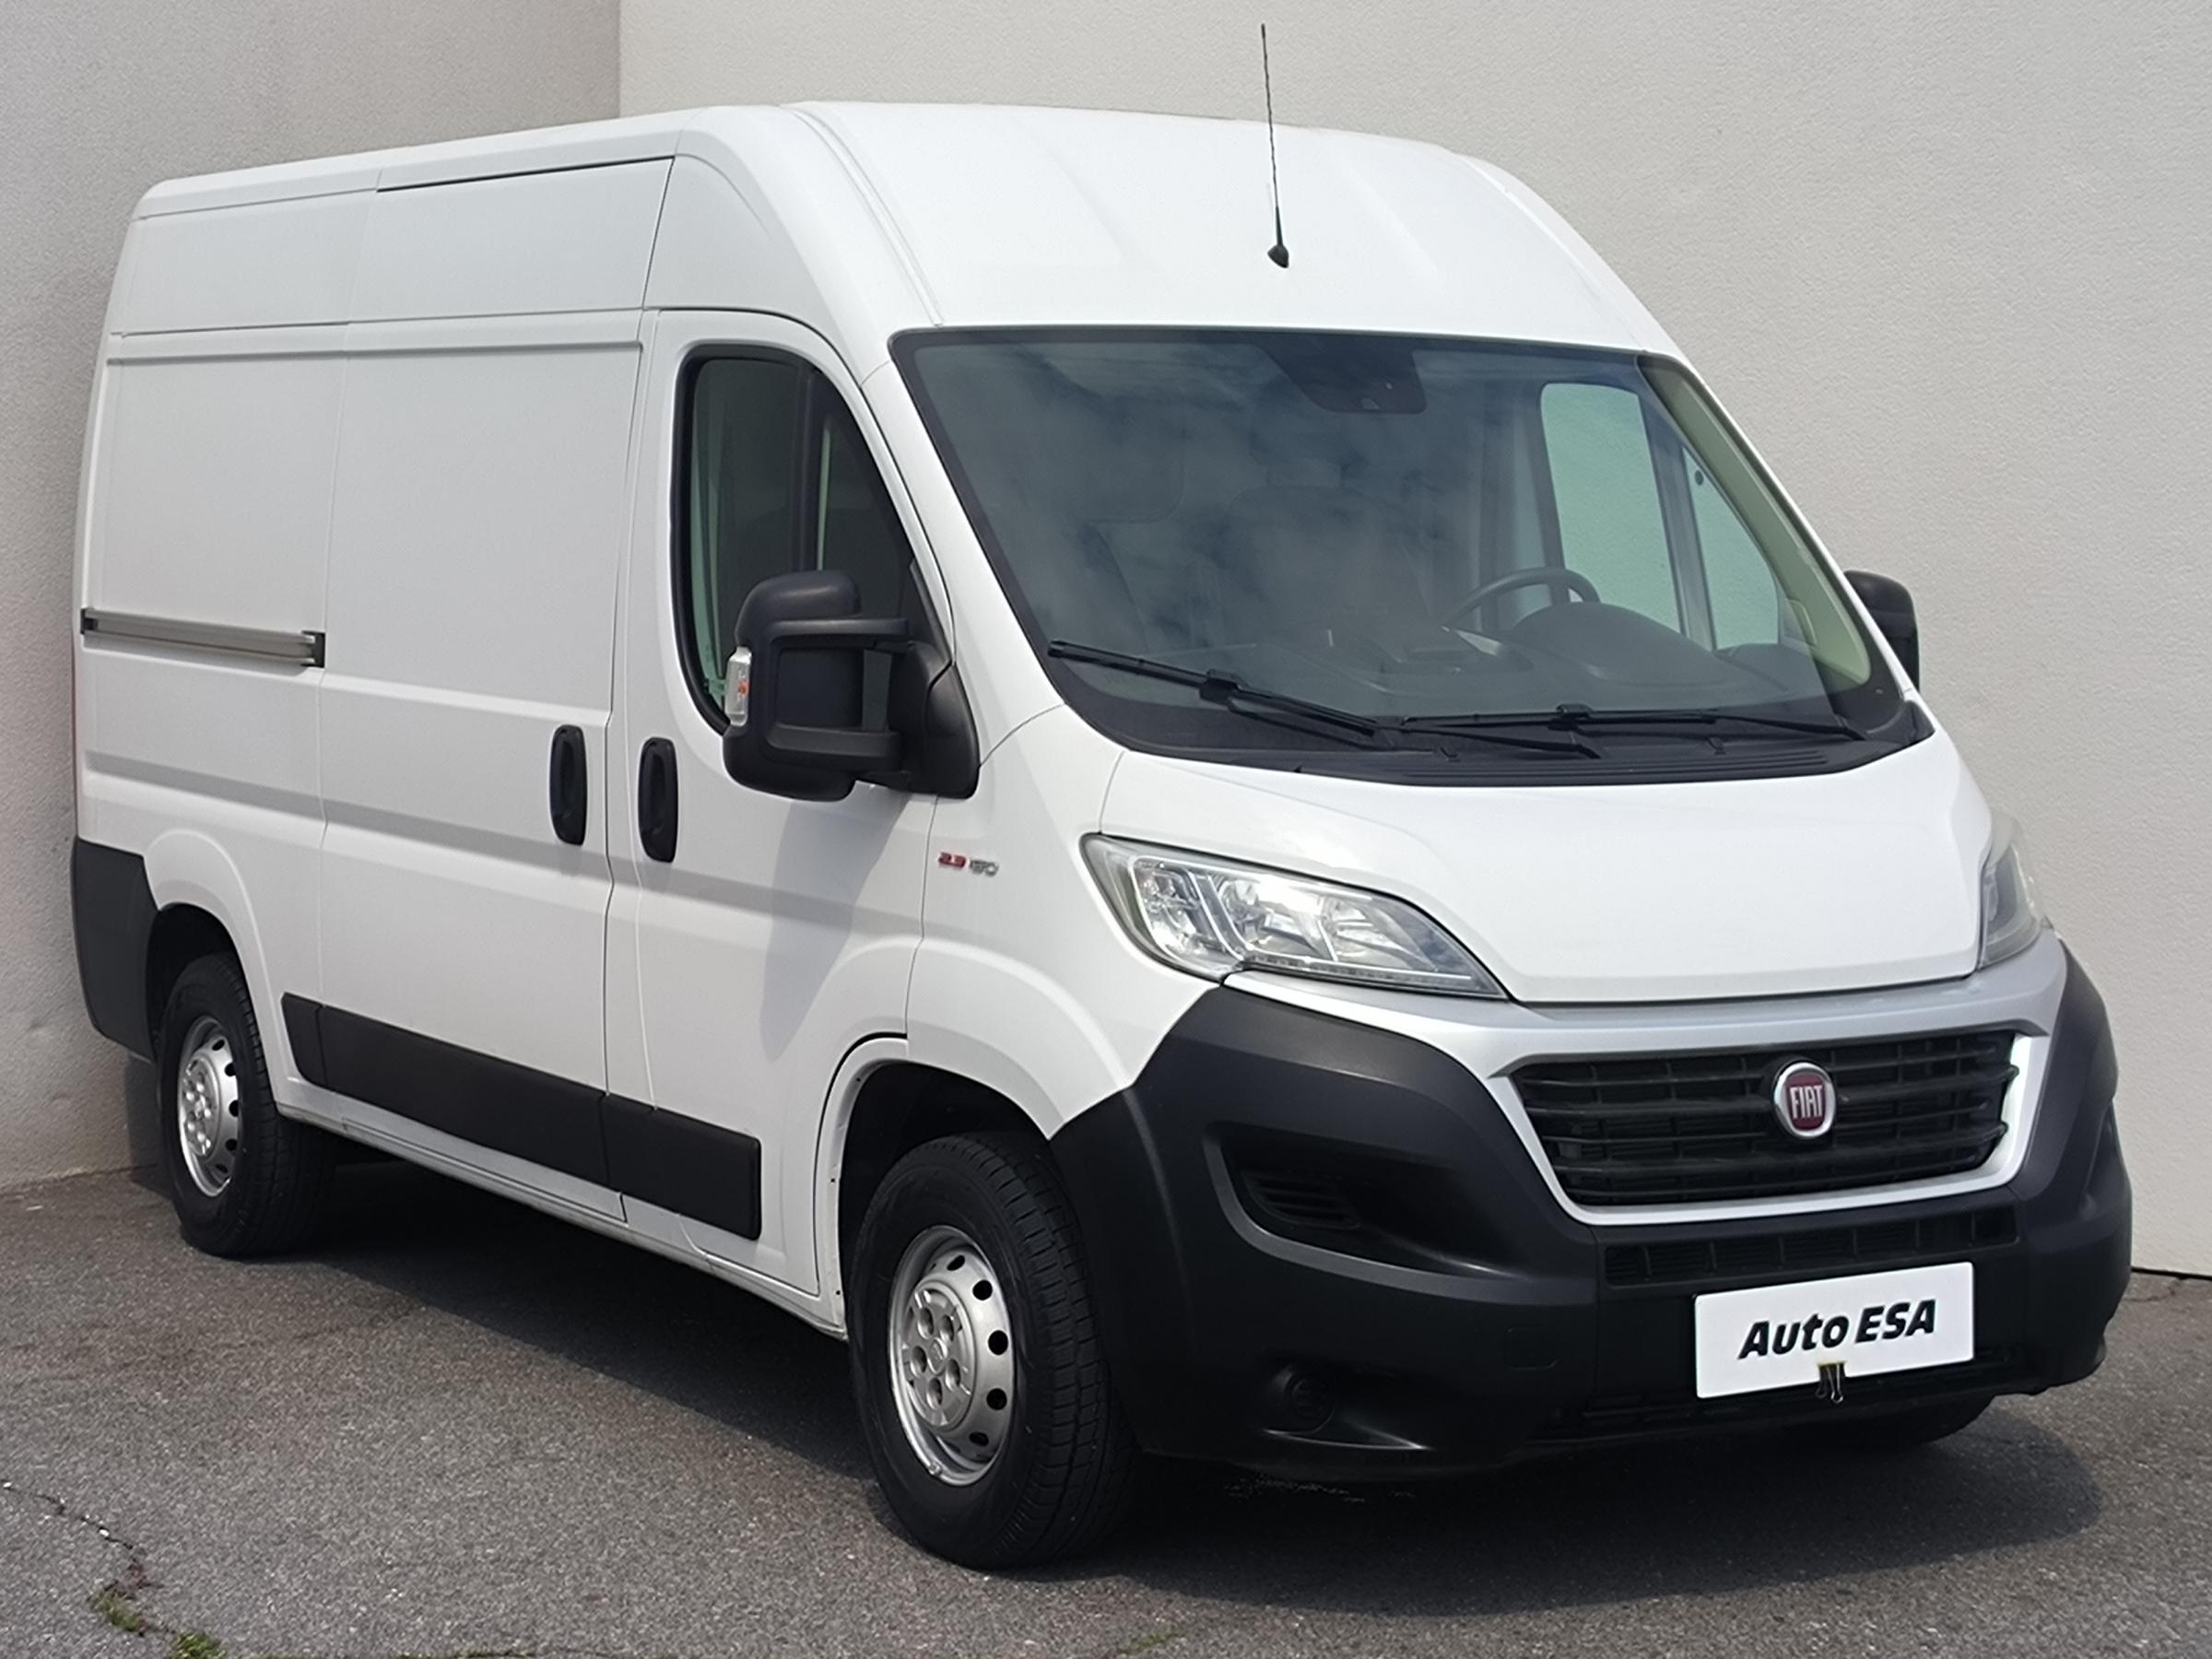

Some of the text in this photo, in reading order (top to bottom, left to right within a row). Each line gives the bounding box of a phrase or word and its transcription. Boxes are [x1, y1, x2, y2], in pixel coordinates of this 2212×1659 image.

[1790, 1085, 1823, 1119] FIAT
[1737, 1299, 1936, 1359] Auto ESA
